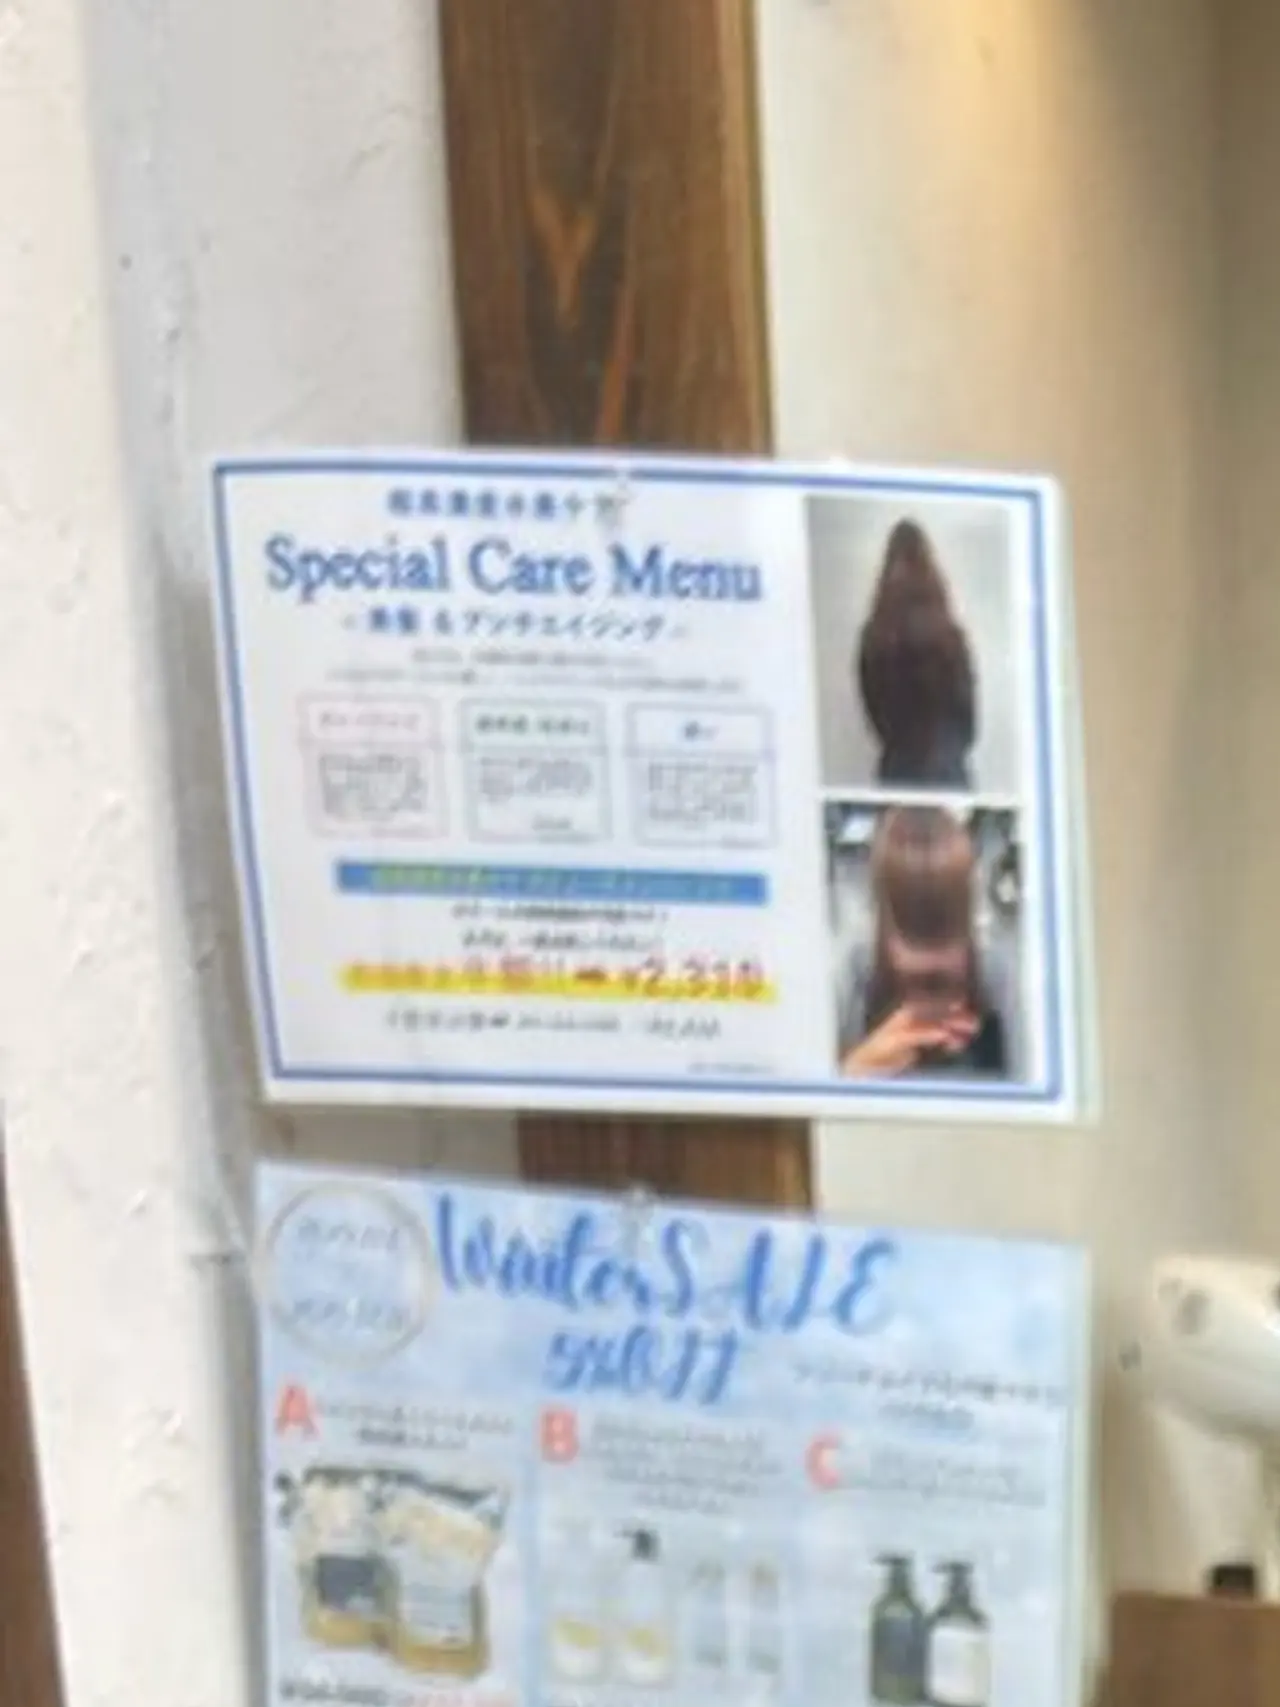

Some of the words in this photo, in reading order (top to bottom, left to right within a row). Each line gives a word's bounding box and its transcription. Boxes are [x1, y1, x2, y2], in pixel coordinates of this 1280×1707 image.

[264, 533, 448, 604] Special
[467, 537, 594, 596] Care
[608, 541, 764, 602] Menu
[274, 1386, 318, 1439] A
[539, 1408, 581, 1463] B
[805, 1432, 844, 1490] C
